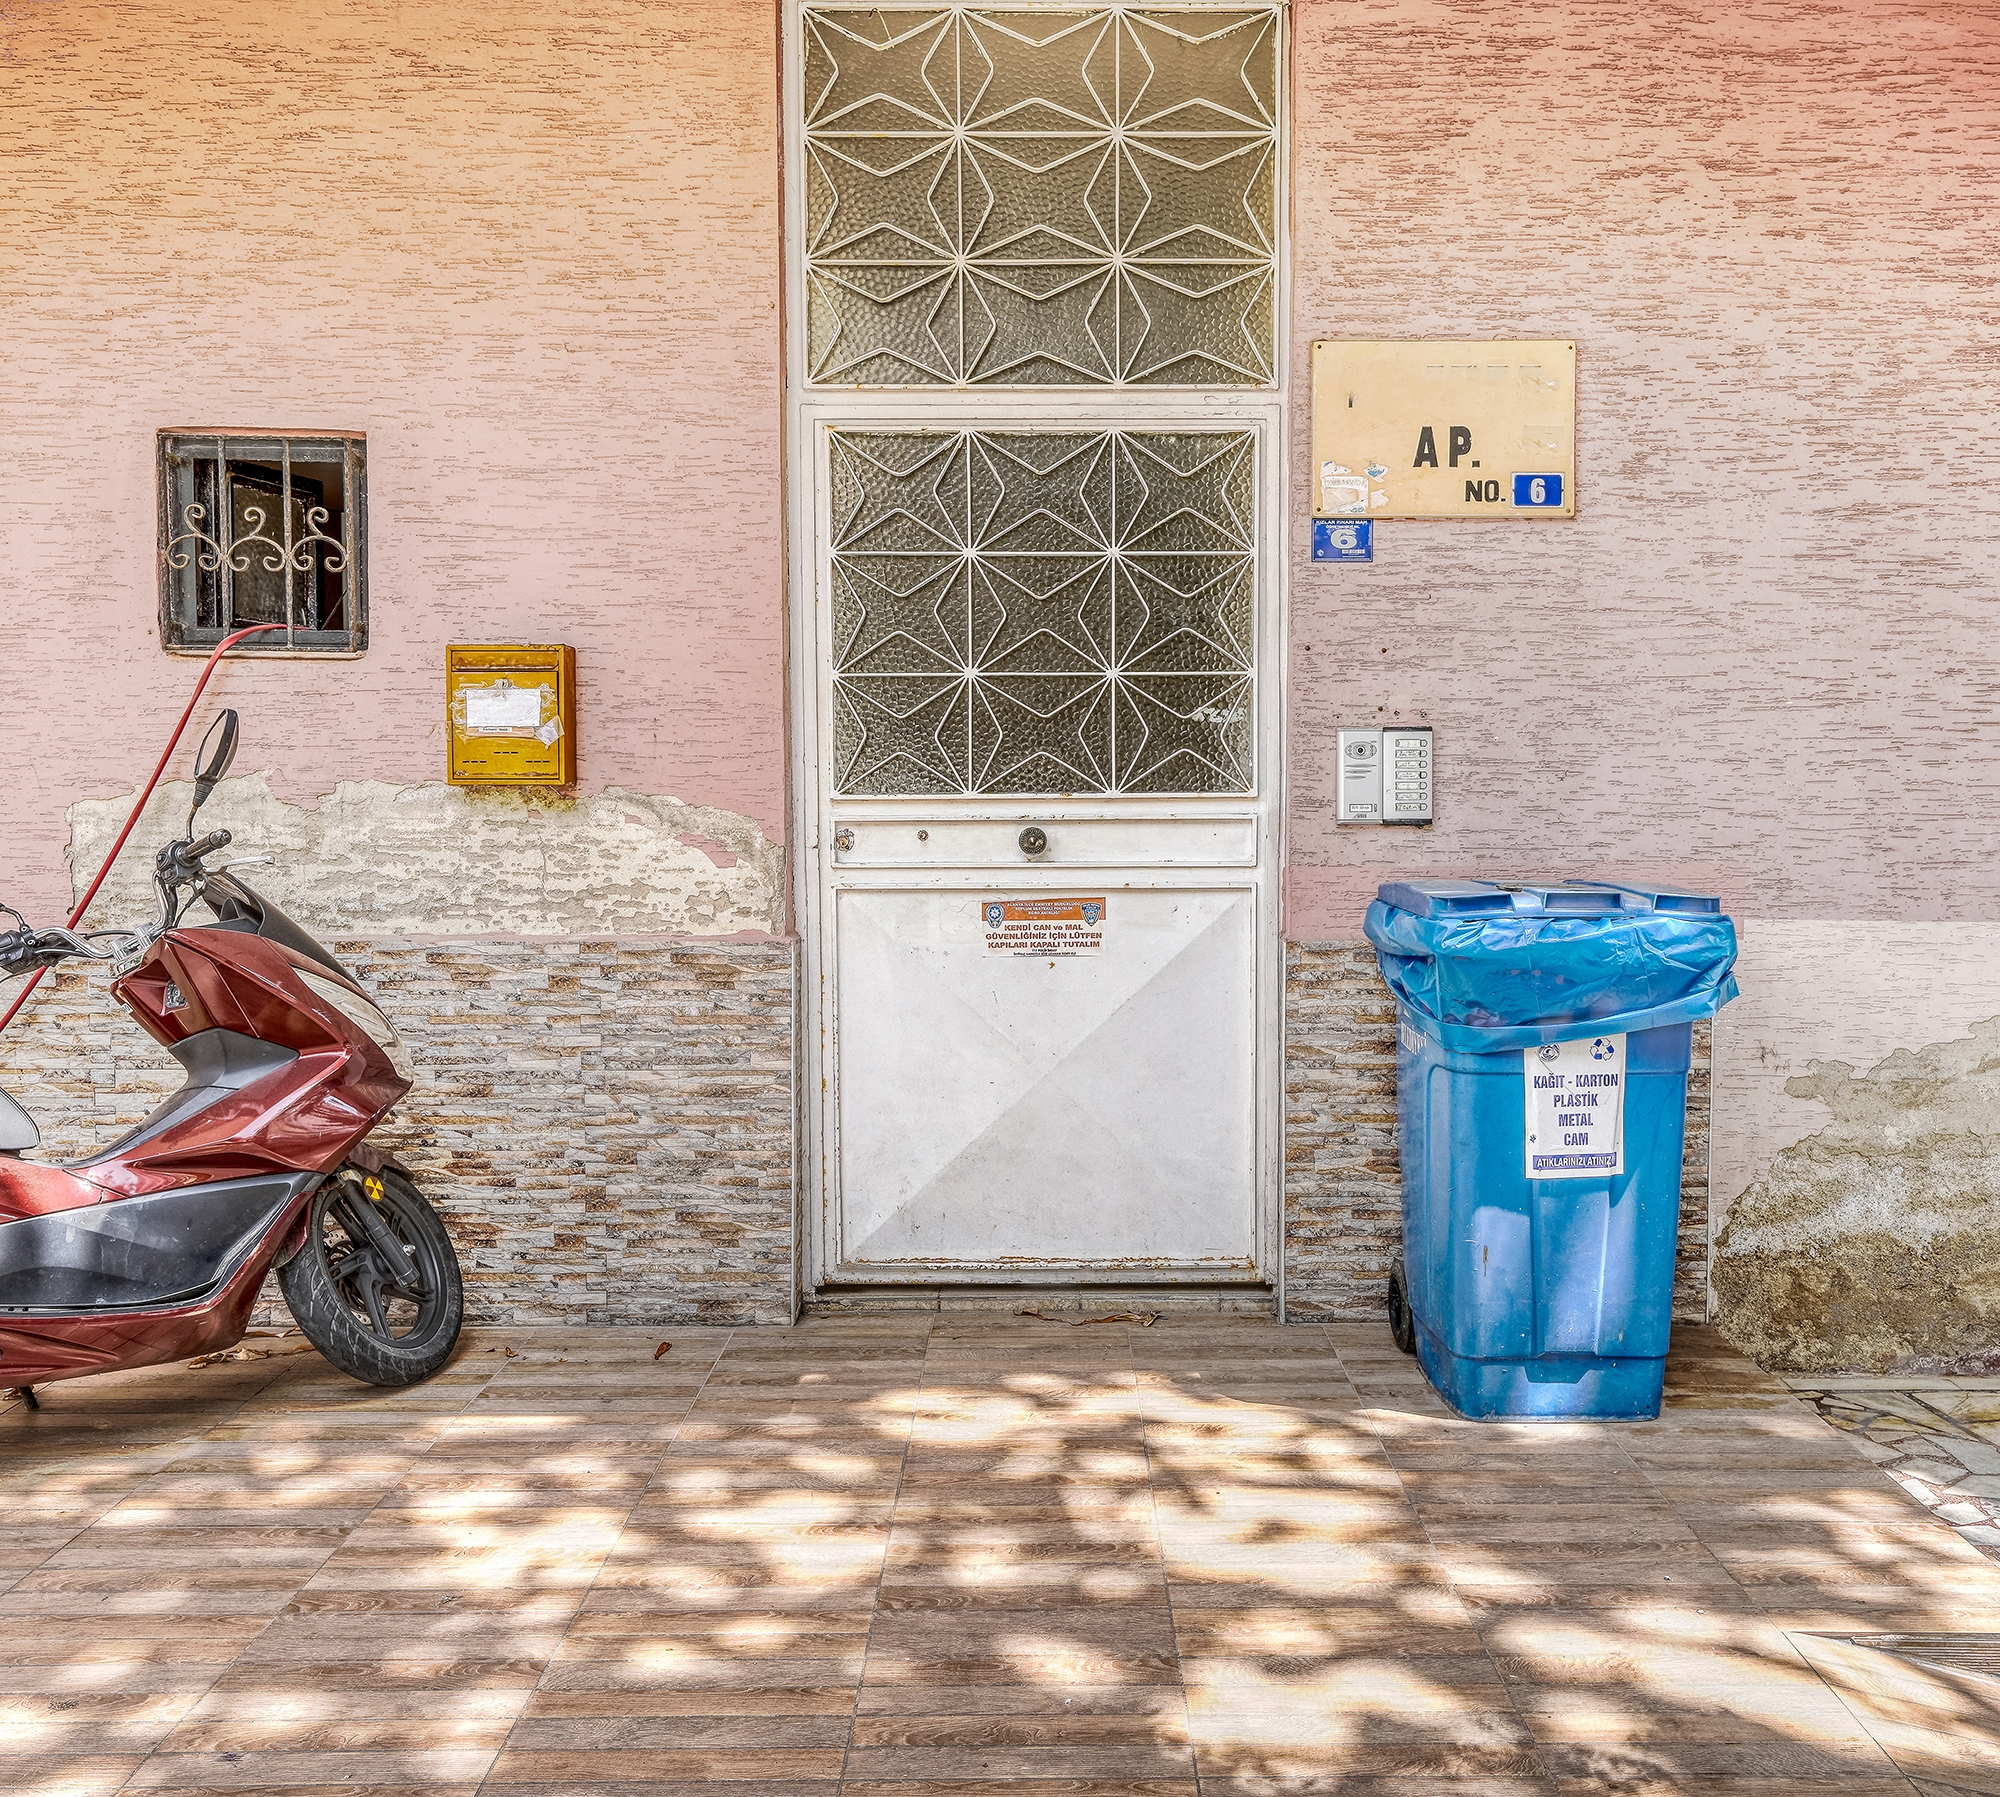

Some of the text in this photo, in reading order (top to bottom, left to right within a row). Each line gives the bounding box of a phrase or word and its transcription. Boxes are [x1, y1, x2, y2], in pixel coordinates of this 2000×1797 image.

[1412, 425, 1481, 468] AP.
[1464, 480, 1507, 503] NO.
[1529, 477, 1547, 505] 6
[1330, 529, 1358, 549] 6
[985, 931, 1102, 940] GÜVENLİĞİNİZ İÇİN LÜTFEN
[1004, 923, 1031, 931] KENDİ
[988, 941, 1028, 949] KAPILARI
[1534, 1072, 1565, 1089] KAĞIT
[1575, 1073, 1619, 1088] KARTON
[1553, 1091, 1599, 1108] PLASTİK
[1558, 1113, 1594, 1127] METAL
[1563, 1132, 1589, 1146] CAM
